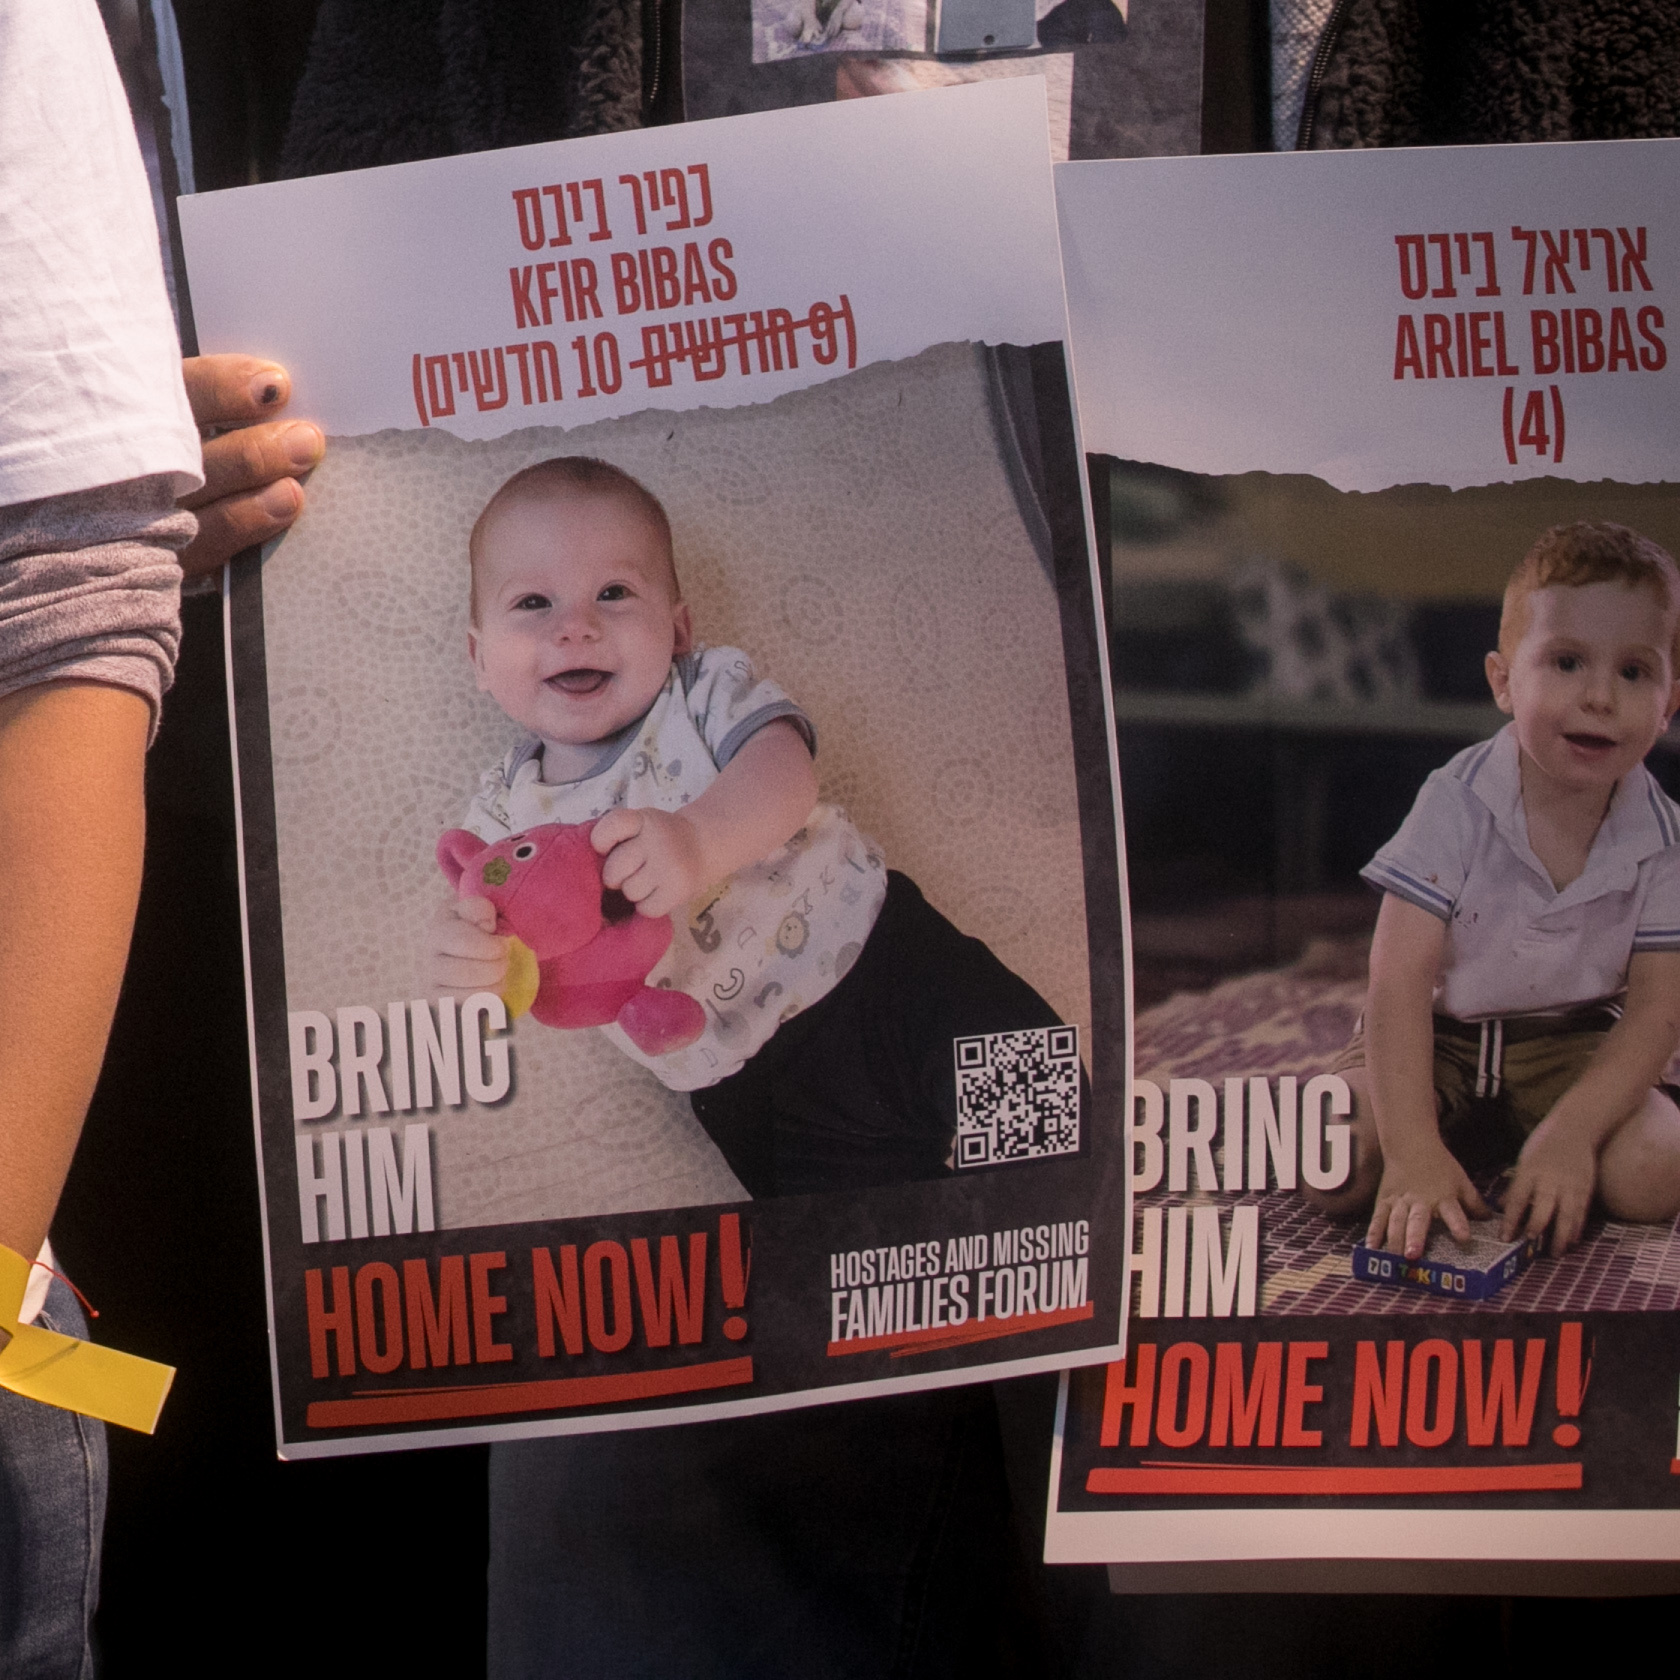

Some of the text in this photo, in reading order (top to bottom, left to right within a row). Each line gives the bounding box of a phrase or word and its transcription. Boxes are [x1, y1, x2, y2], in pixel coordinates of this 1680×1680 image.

[511, 162, 714, 252] כפיר ביבס
[508, 237, 738, 330] KFIR BIBAS
[1394, 225, 1654, 301] אריאל ביבס
[571, 330, 623, 399] 10
[1393, 305, 1668, 380] ARIEL BIBAS
[1502, 385, 1566, 465] (4)
[287, 989, 513, 1121] BRING
[1132, 1073, 1352, 1193] BRING
[295, 1122, 436, 1244] HIM
[304, 1212, 752, 1380] HOME NOW!
[830, 1219, 1090, 1289] HOSTAGES AND MISSING
[831, 1256, 1089, 1343] FAMILIES FORUM
[1129, 1205, 1259, 1319] HIM
[1100, 1321, 1585, 1449] HOME NOW!
